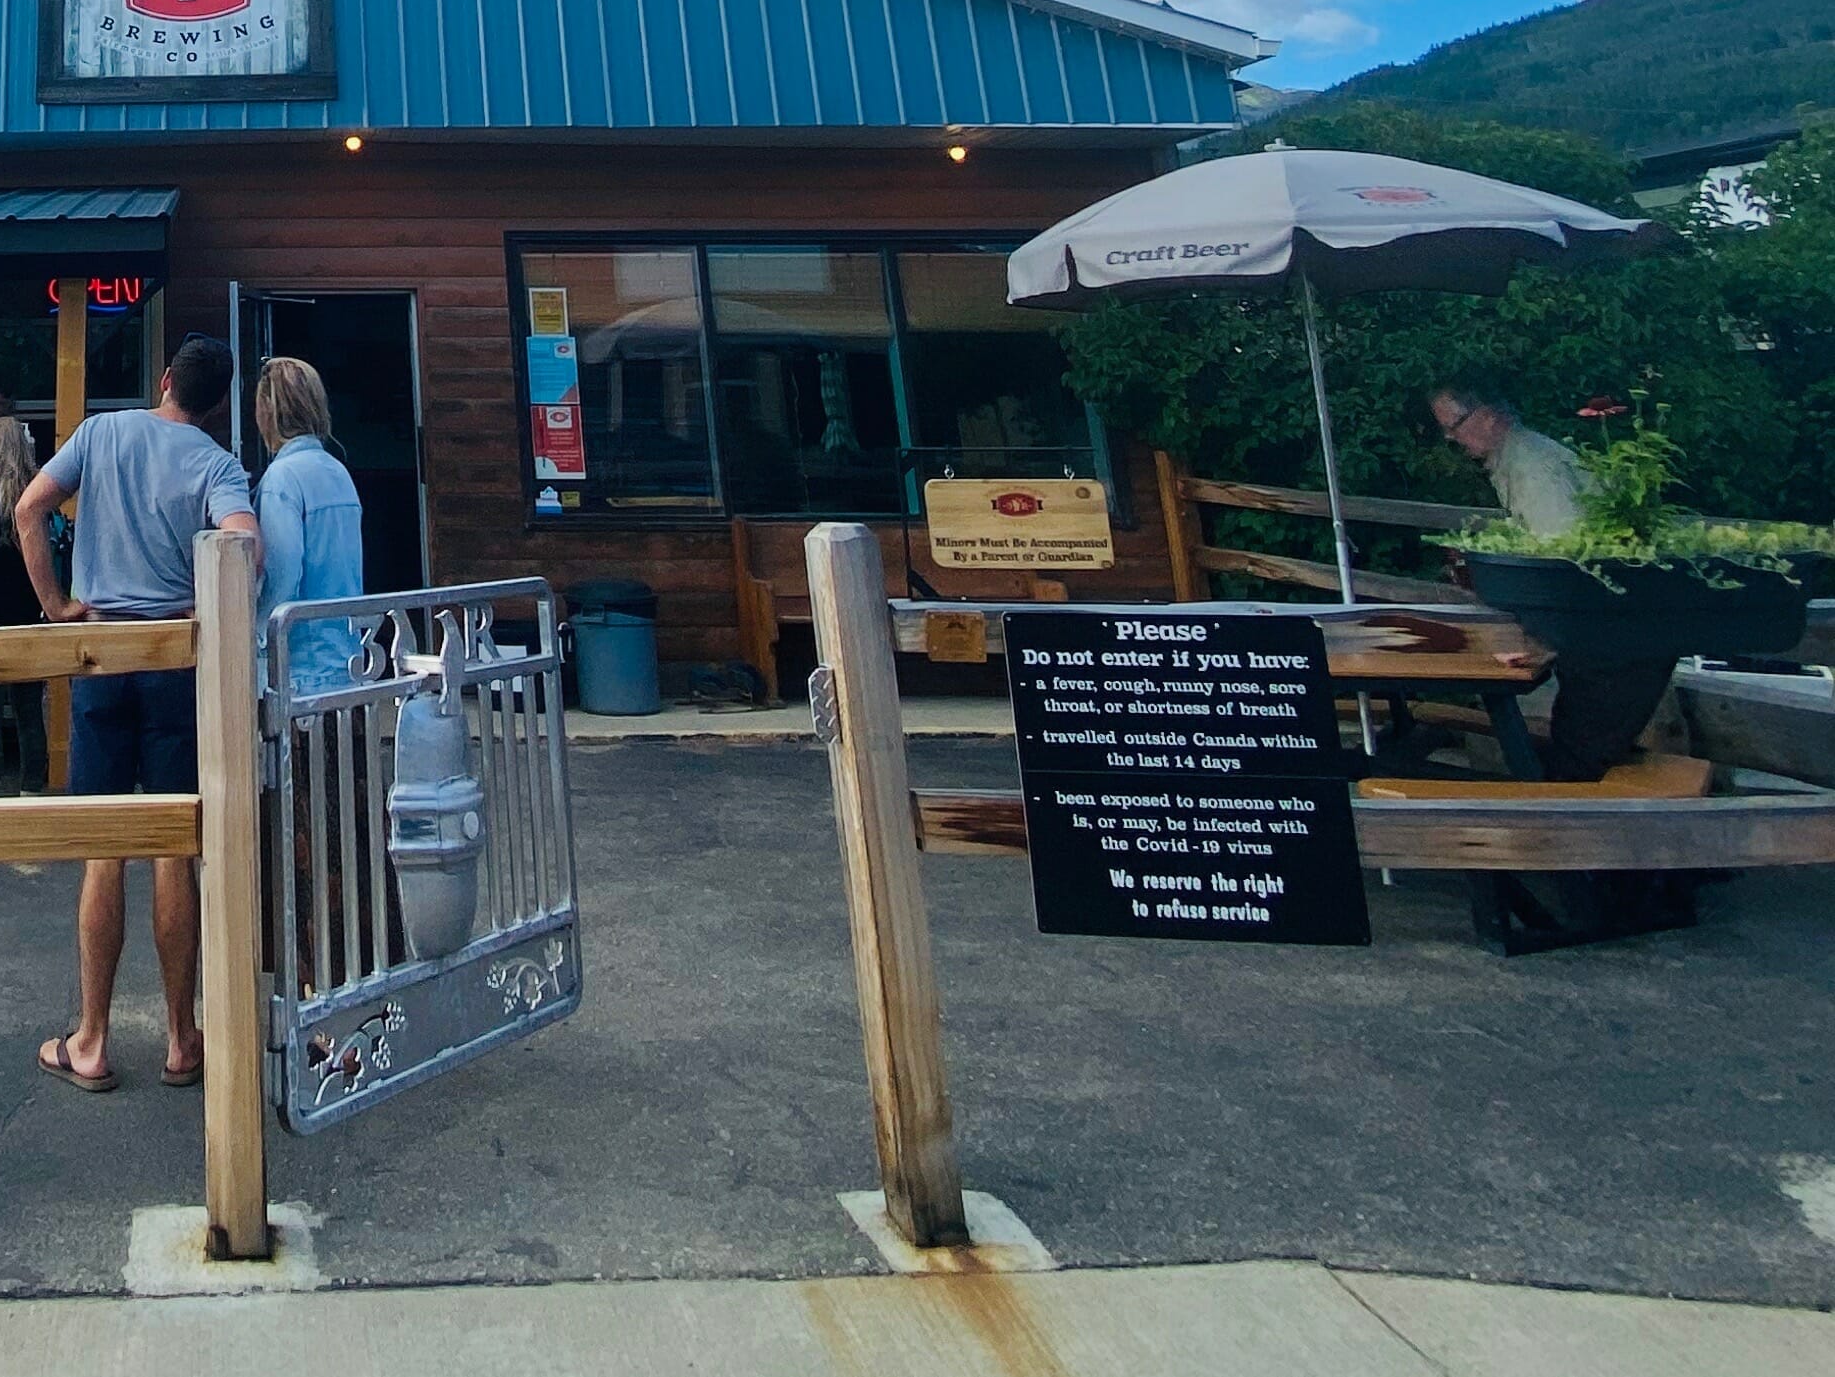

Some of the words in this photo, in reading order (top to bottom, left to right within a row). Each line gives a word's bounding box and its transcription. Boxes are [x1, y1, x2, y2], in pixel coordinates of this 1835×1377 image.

[100, 15, 275, 45] BREWING
[166, 51, 198, 63] CO
[1106, 246, 1176, 265] Craft
[1180, 242, 1250, 259] Beer
[935, 537, 977, 548] Minors
[980, 537, 1009, 548] Must
[1013, 538, 1027, 548] Be
[1030, 537, 1108, 550] Accompanied
[953, 551, 967, 563] By
[971, 554, 978, 562] a
[981, 552, 1019, 562] Parent
[1023, 554, 1035, 562] or
[1038, 552, 1094, 562] Guardian
[1115, 621, 1207, 641] Please
[1022, 649, 1050, 664] Do
[1056, 650, 1094, 665] not
[1101, 651, 1163, 666] enter
[1172, 650, 1190, 667] if
[1196, 654, 1241, 671] you
[1247, 652, 1310, 669] have:
[1036, 679, 1046, 690] a
[1053, 677, 1097, 692] fever,
[1104, 678, 1160, 694] cough,
[1163, 682, 1214, 696] runny
[1220, 683, 1265, 695] nose,
[1269, 684, 1306, 694] sore
[1044, 698, 1100, 714] throat,
[1105, 703, 1123, 713] or
[1128, 700, 1210, 715] shortness
[1216, 702, 1233, 715] of
[1239, 702, 1297, 716] breath
[1043, 730, 1117, 744] travelled
[1124, 732, 1186, 745] outside
[1193, 733, 1258, 747] Canada
[1260, 734, 1317, 748] within
[1107, 752, 1134, 766] the
[1137, 753, 1169, 768] last
[1174, 756, 1195, 768] 14
[1201, 755, 1241, 772] days
[1055, 791, 1096, 805] been
[1101, 794, 1171, 810] exposed
[1176, 795, 1194, 808] to
[1199, 798, 1274, 810] someone
[1278, 797, 1315, 811] who
[1073, 814, 1093, 829] is,
[1098, 818, 1116, 828] or
[1122, 819, 1161, 833] may,
[1166, 817, 1186, 830] be
[1193, 818, 1263, 833] infected
[1268, 820, 1308, 834] with
[1101, 836, 1128, 850] the
[1227, 840, 1273, 855] virus
[1109, 869, 1134, 888] We
[1143, 875, 1201, 890] reserve
[1211, 872, 1237, 891] the
[1243, 873, 1284, 898] right
[1132, 899, 1148, 917] to
[1156, 898, 1207, 919] refuse
[1212, 902, 1269, 921] service
